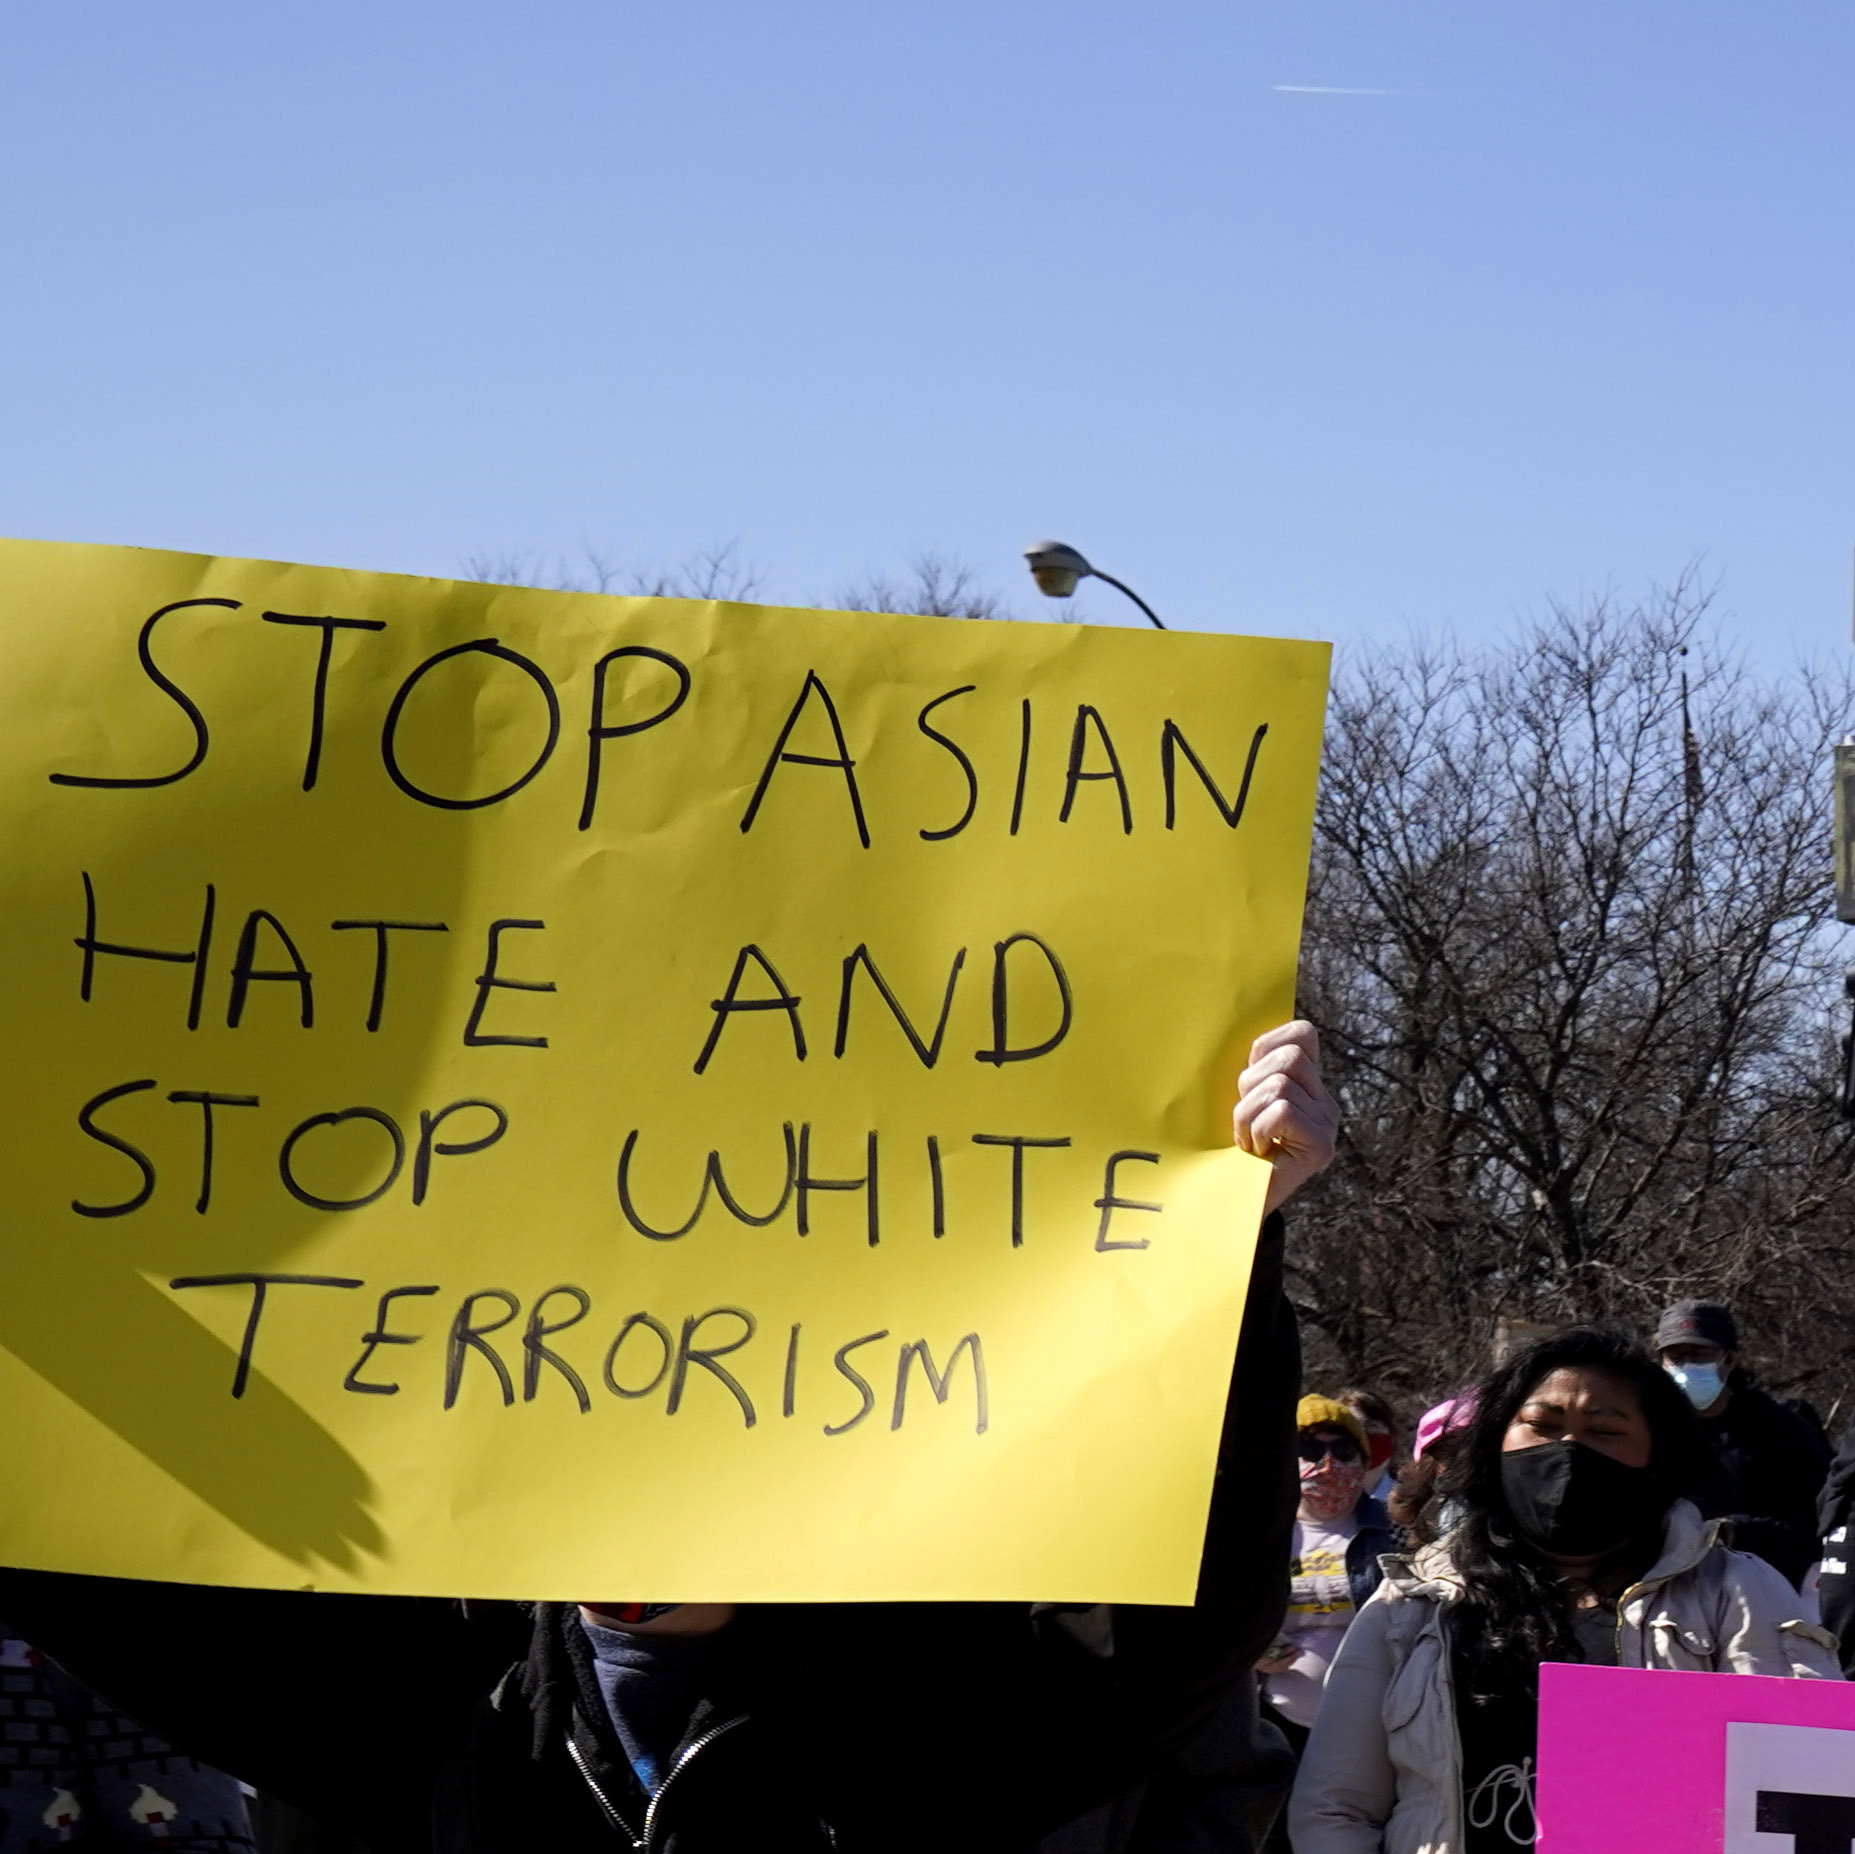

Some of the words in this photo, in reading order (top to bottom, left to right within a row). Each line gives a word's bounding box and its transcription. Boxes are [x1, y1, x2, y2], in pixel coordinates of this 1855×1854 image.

[50, 597, 692, 831] STOP
[740, 669, 1269, 849] ASIAN
[74, 872, 557, 1048] HATE
[694, 932, 1073, 1074] AND
[72, 1079, 510, 1219] STOP
[617, 1120, 1163, 1252] WHITE
[169, 1273, 989, 1435] TERRORISM
